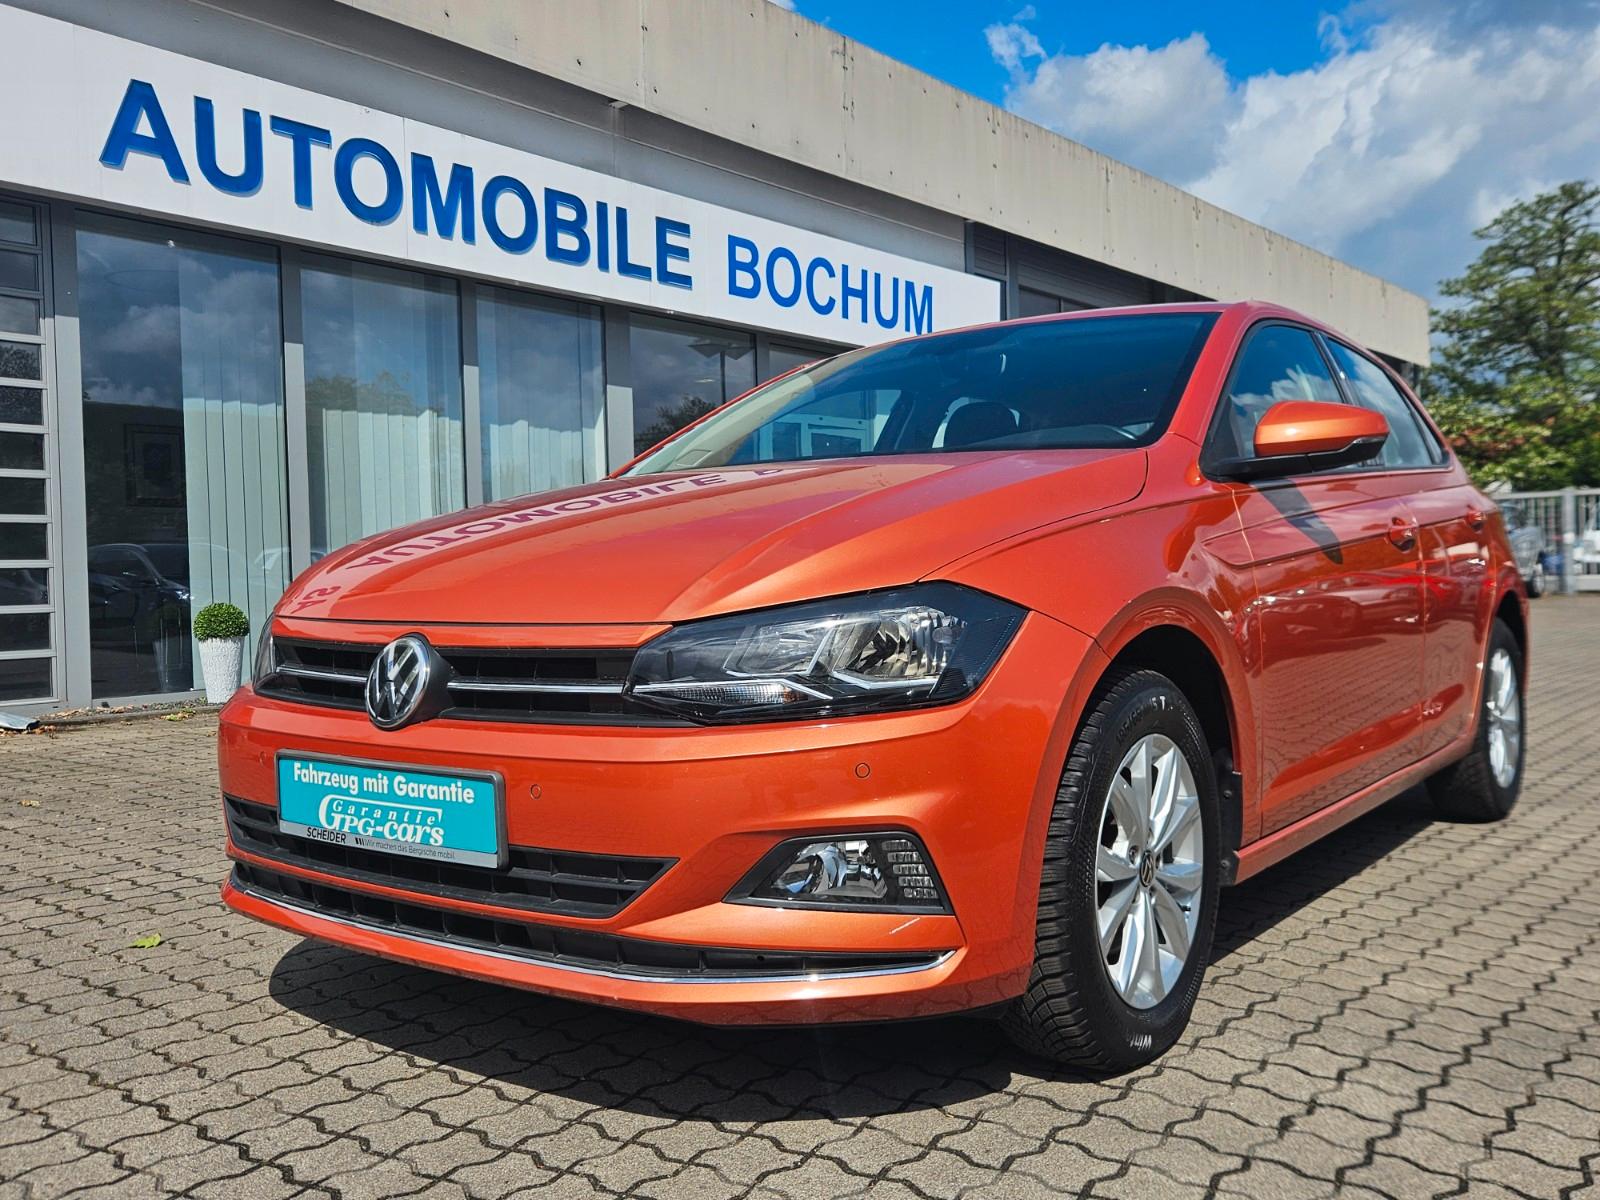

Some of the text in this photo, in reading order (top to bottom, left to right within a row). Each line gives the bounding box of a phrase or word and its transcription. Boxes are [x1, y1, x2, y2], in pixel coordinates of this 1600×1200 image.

[100, 78, 933, 336] AUTOMOBILE BOCHUM
[293, 762, 475, 804] Fahrzeug mit Garantie
[332, 799, 436, 825] Garantie
[306, 827, 347, 844] SCHEIDER
